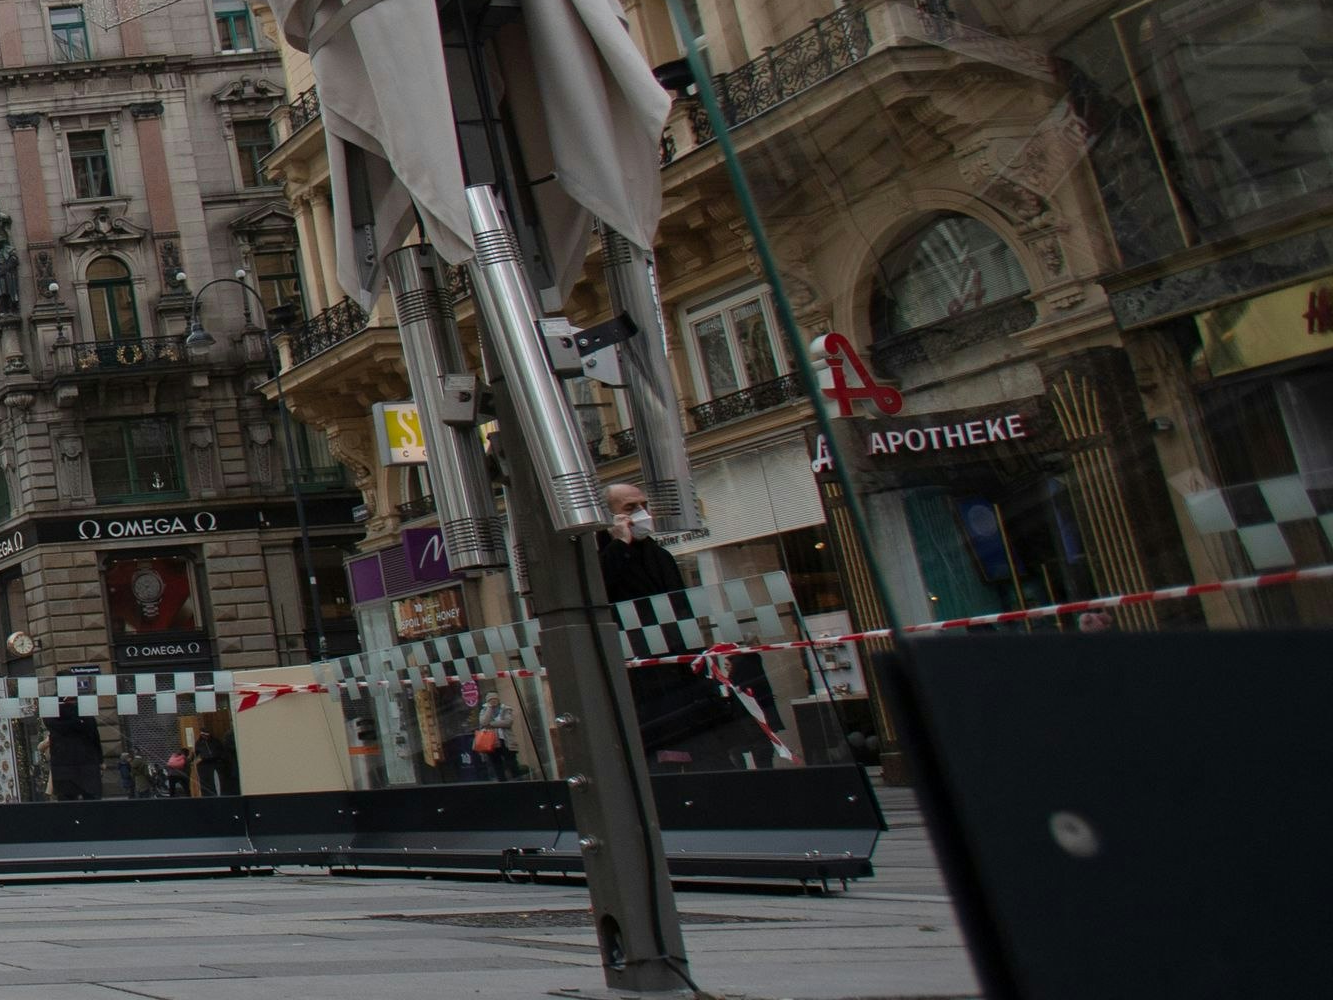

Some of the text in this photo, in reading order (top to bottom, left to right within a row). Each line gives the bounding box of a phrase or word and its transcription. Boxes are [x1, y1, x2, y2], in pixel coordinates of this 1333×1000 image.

[869, 413, 1027, 456] APOTHEKE
[107, 516, 187, 537] OMEGA
[681, 527, 711, 542] suisse
[436, 607, 461, 622] HONEY
[141, 644, 184, 657] OMEGA
